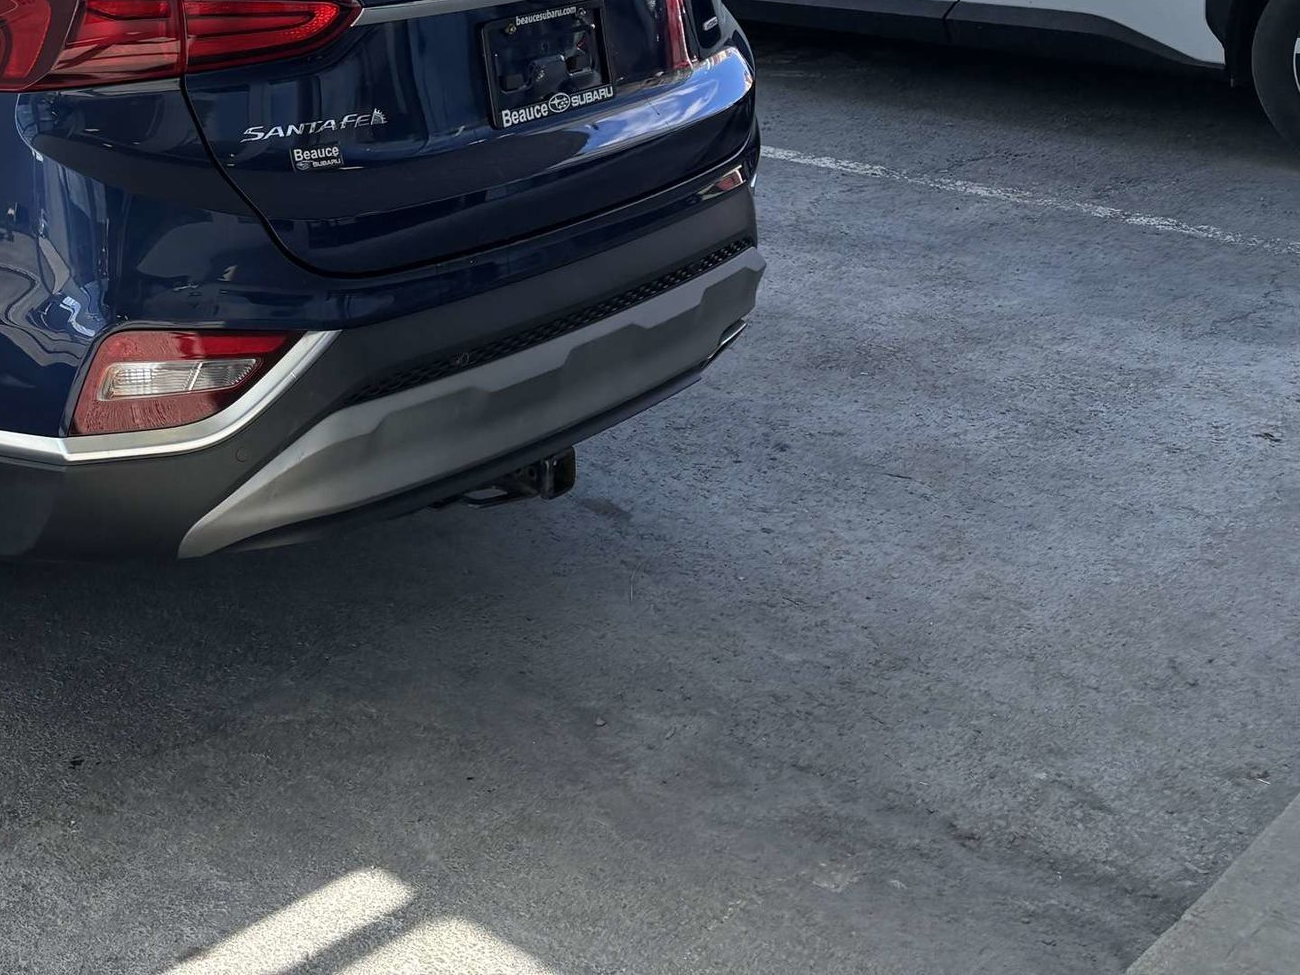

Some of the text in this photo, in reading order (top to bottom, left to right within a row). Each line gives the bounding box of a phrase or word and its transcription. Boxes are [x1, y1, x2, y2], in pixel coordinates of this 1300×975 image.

[515, 6, 577, 25] beaucesubaru.com
[501, 86, 613, 128] Beauce SUBARU
[293, 146, 339, 162] Beauce
[312, 158, 342, 168] SUBARU
